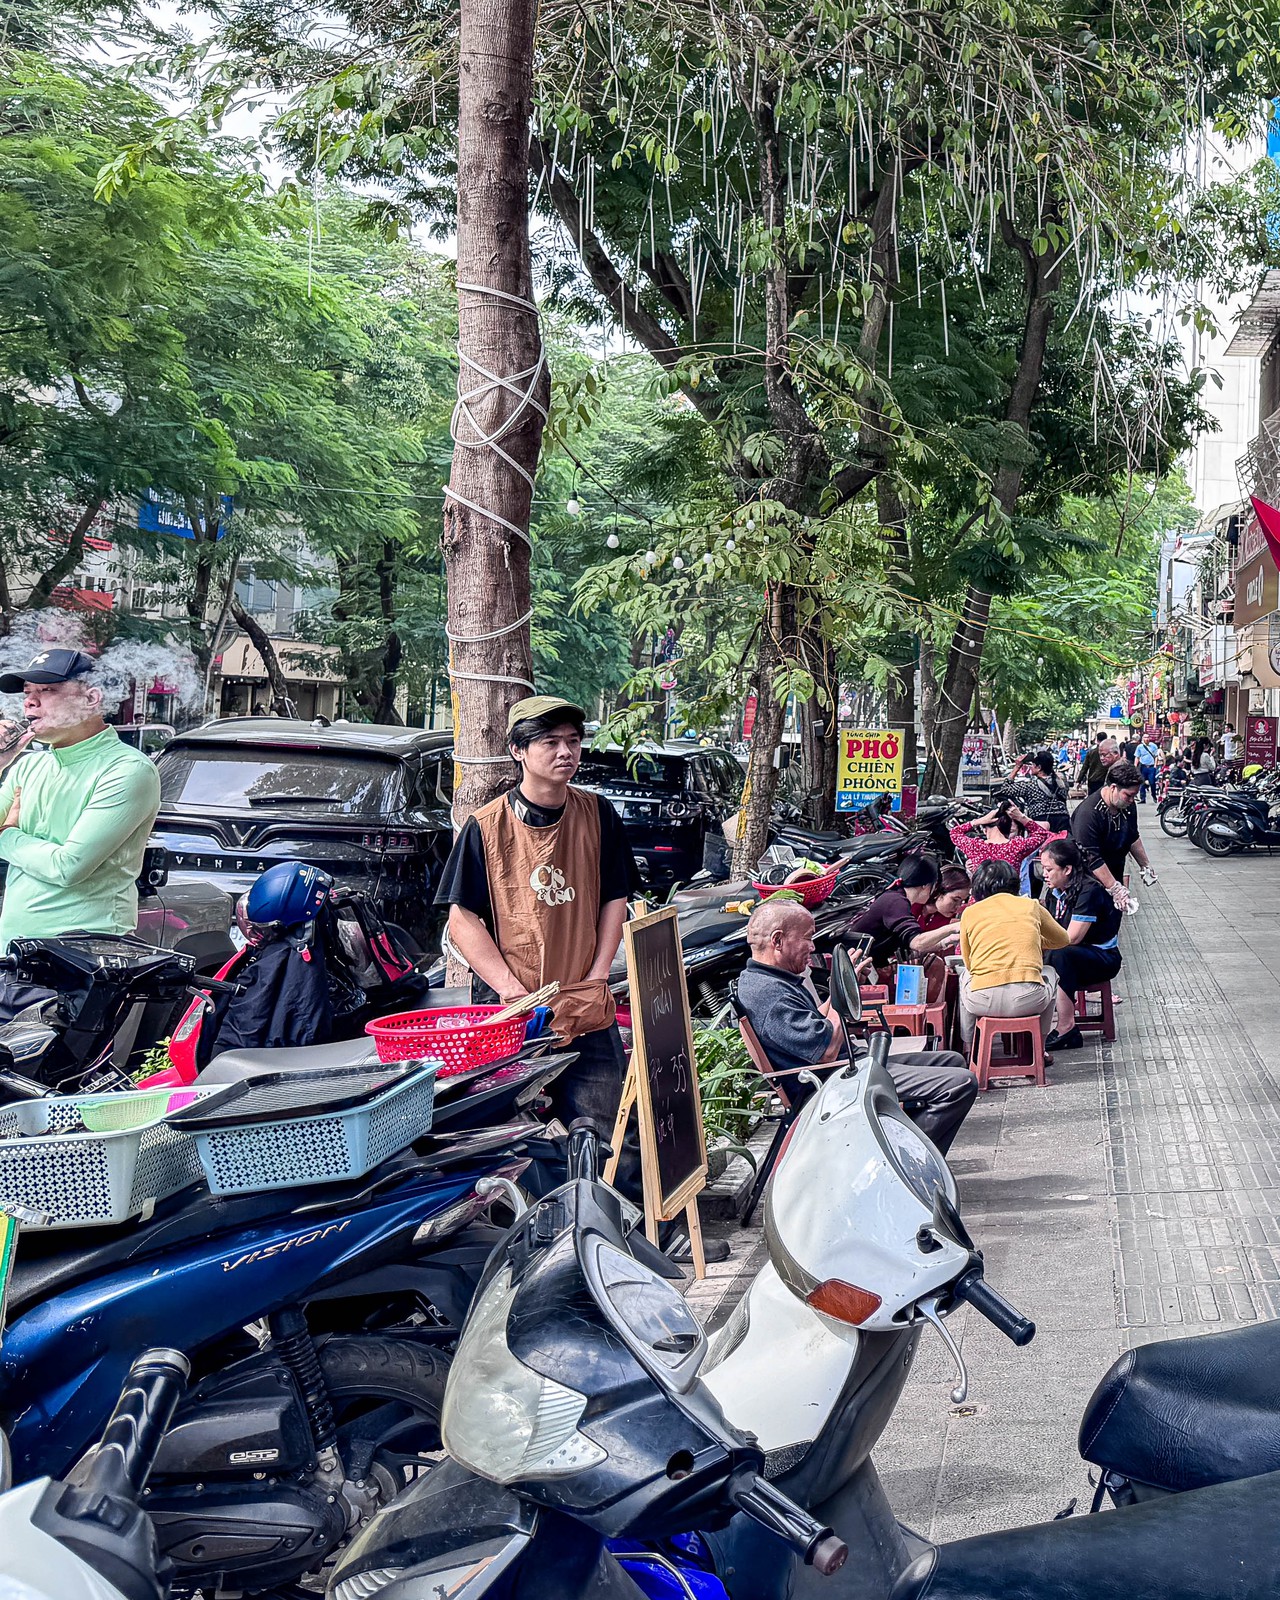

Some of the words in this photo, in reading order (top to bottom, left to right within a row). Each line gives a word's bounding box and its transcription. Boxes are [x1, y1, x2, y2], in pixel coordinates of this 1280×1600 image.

[846, 733, 899, 759] PHỞ
[848, 760, 894, 773] CHIÊN
[221, 1219, 351, 1272] VISION
